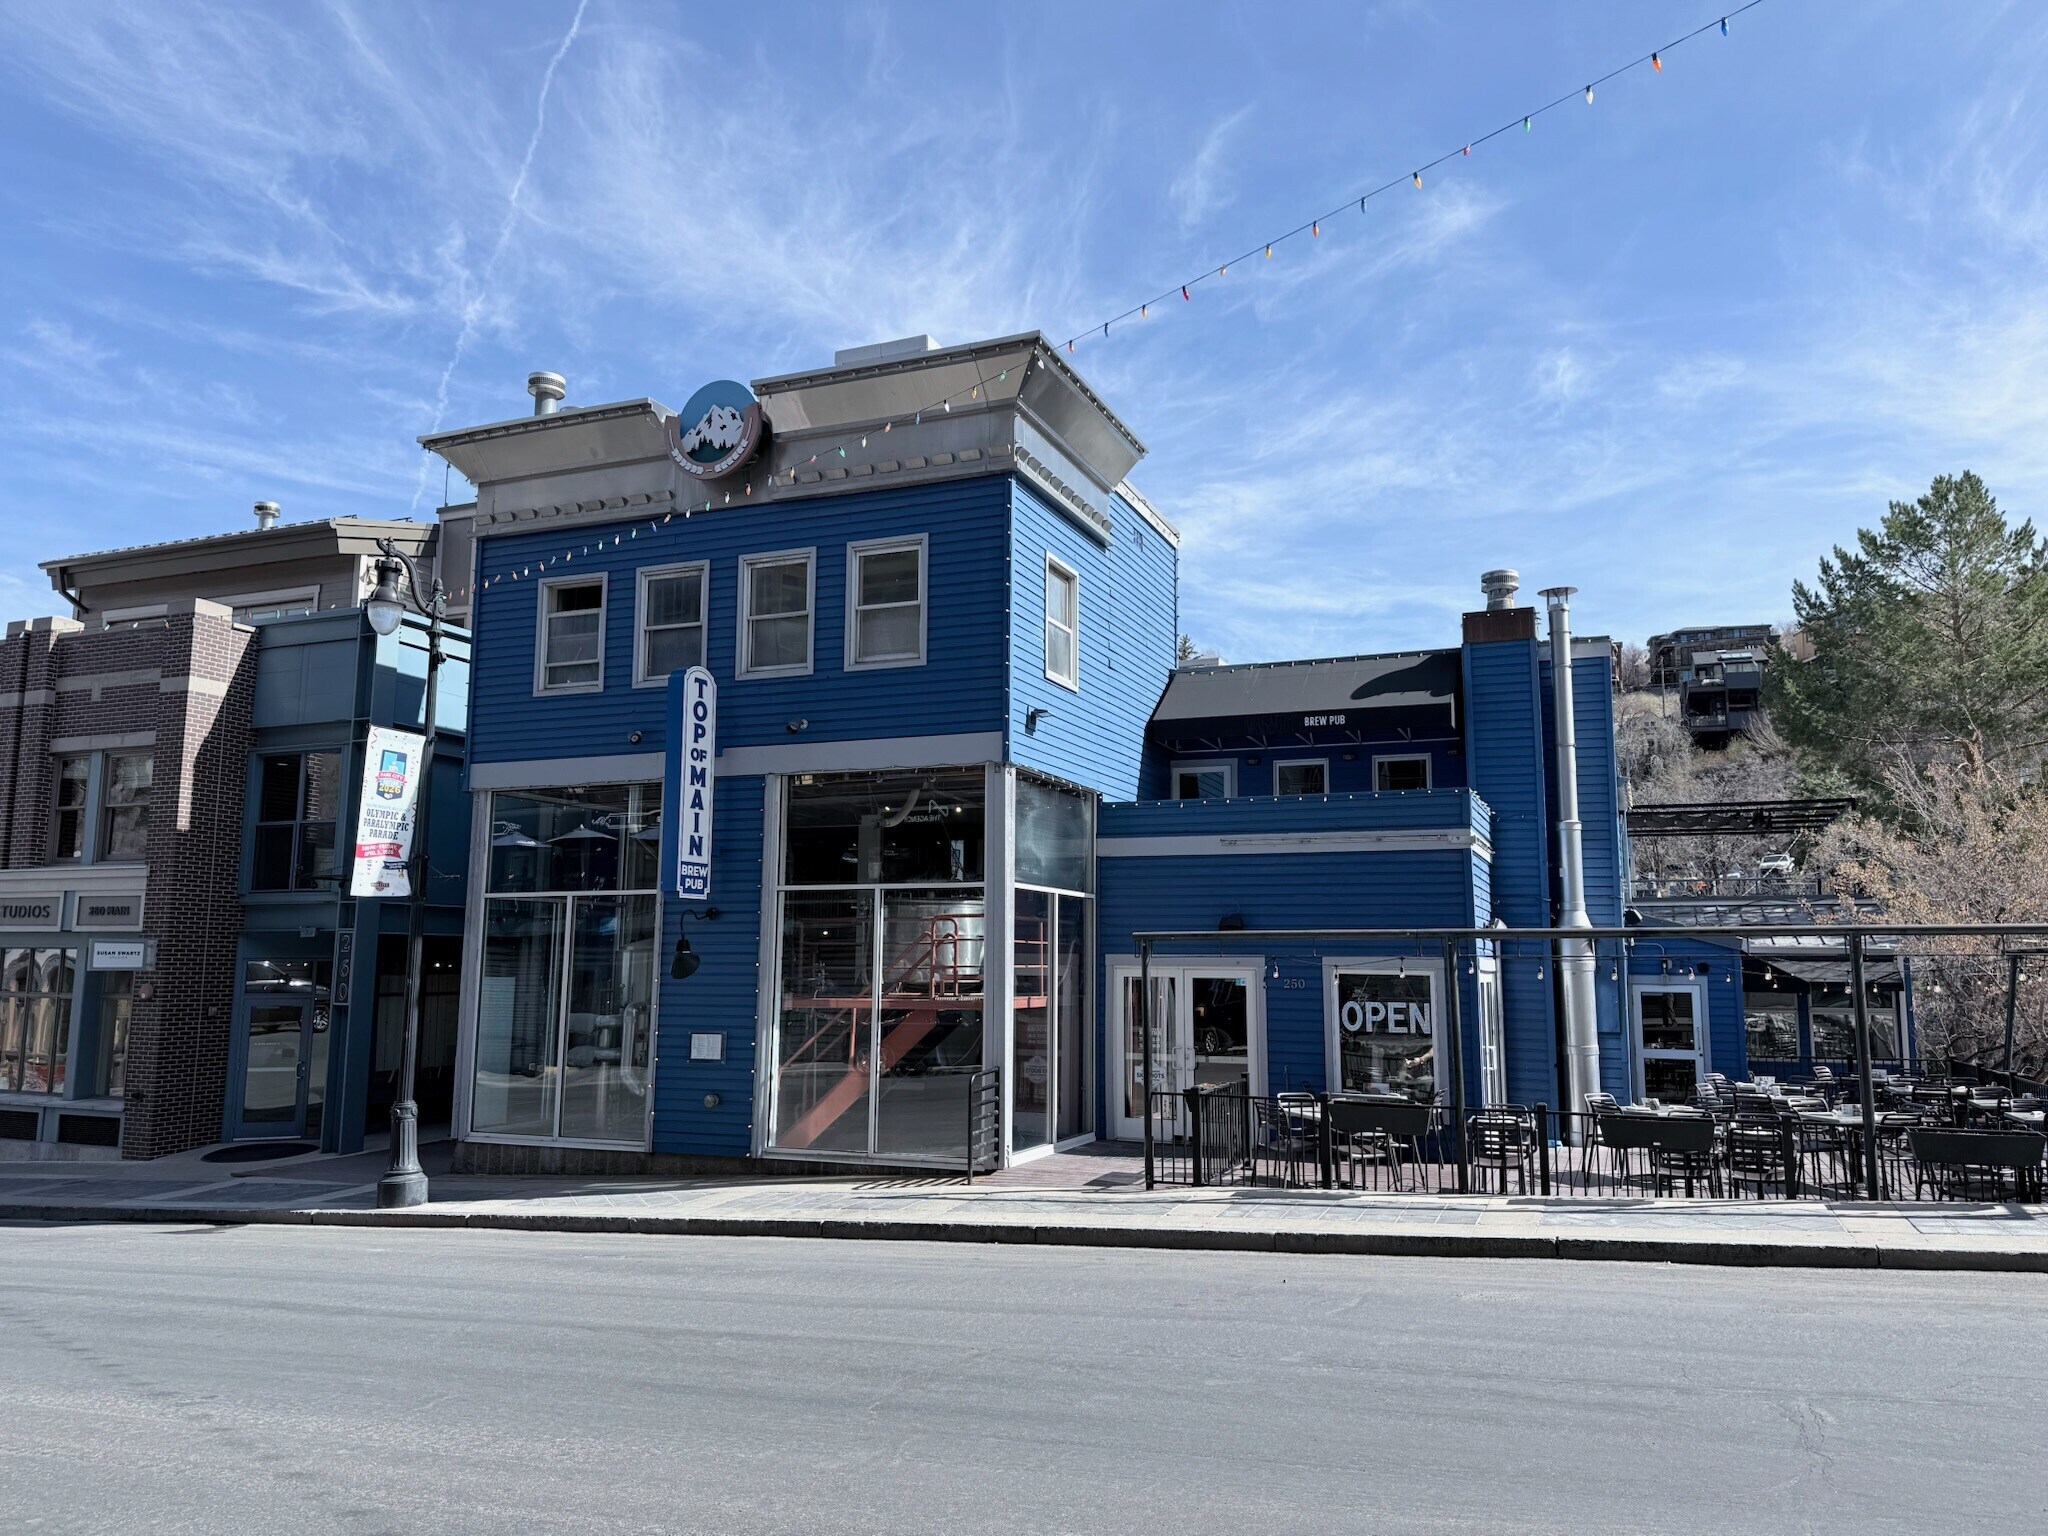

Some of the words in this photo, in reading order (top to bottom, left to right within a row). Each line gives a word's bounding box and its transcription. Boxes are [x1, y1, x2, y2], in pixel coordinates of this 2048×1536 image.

[693, 677, 708, 743] TOP
[1304, 715, 1327, 727] BREW
[1329, 714, 1346, 726] PUB
[690, 747, 707, 762] OF
[379, 784, 401, 794] 2026
[366, 808, 399, 821] OLYMPIC
[400, 812, 407, 822] &
[688, 765, 707, 856] MAIN
[363, 817, 410, 832] PARALYMPIC
[369, 828, 399, 840] PARADE
[681, 864, 708, 878] BREW
[685, 878, 704, 890] PUB
[1, 905, 51, 918] TUDIOS
[107, 906, 130, 916] MAIN
[338, 934, 351, 1002] 260
[1283, 978, 1306, 989] 250
[1341, 1000, 1432, 1035] OPEN
